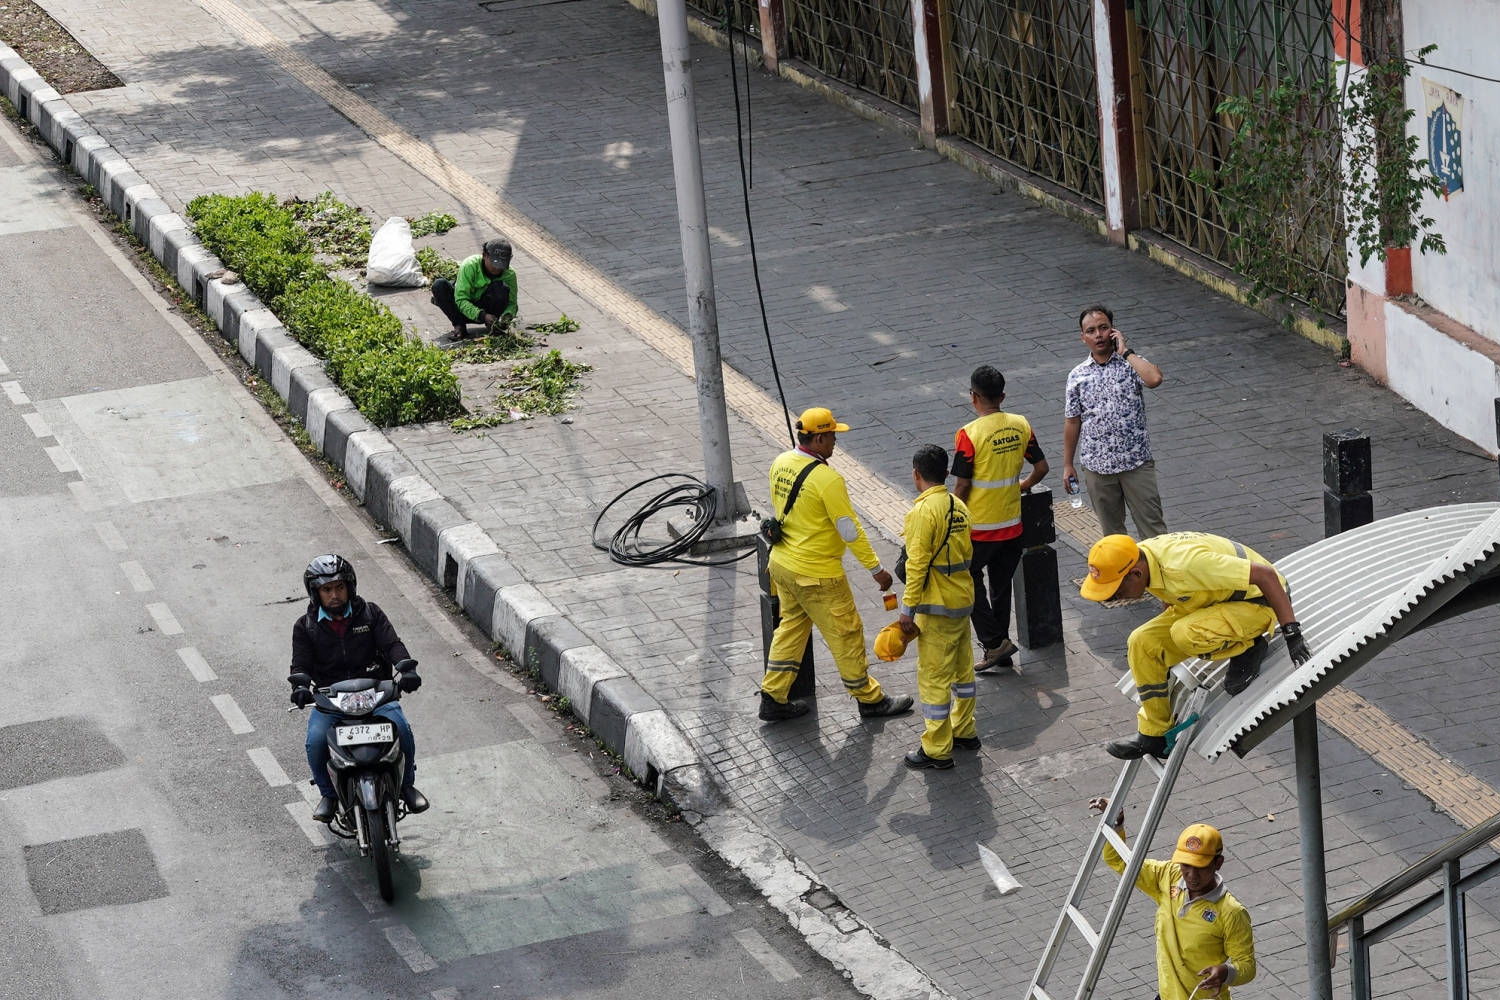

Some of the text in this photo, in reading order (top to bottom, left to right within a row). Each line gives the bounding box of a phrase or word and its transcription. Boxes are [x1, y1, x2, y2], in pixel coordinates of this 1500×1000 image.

[993, 434, 1020, 447] SATGAS
[339, 724, 391, 736] F 4372 HP
